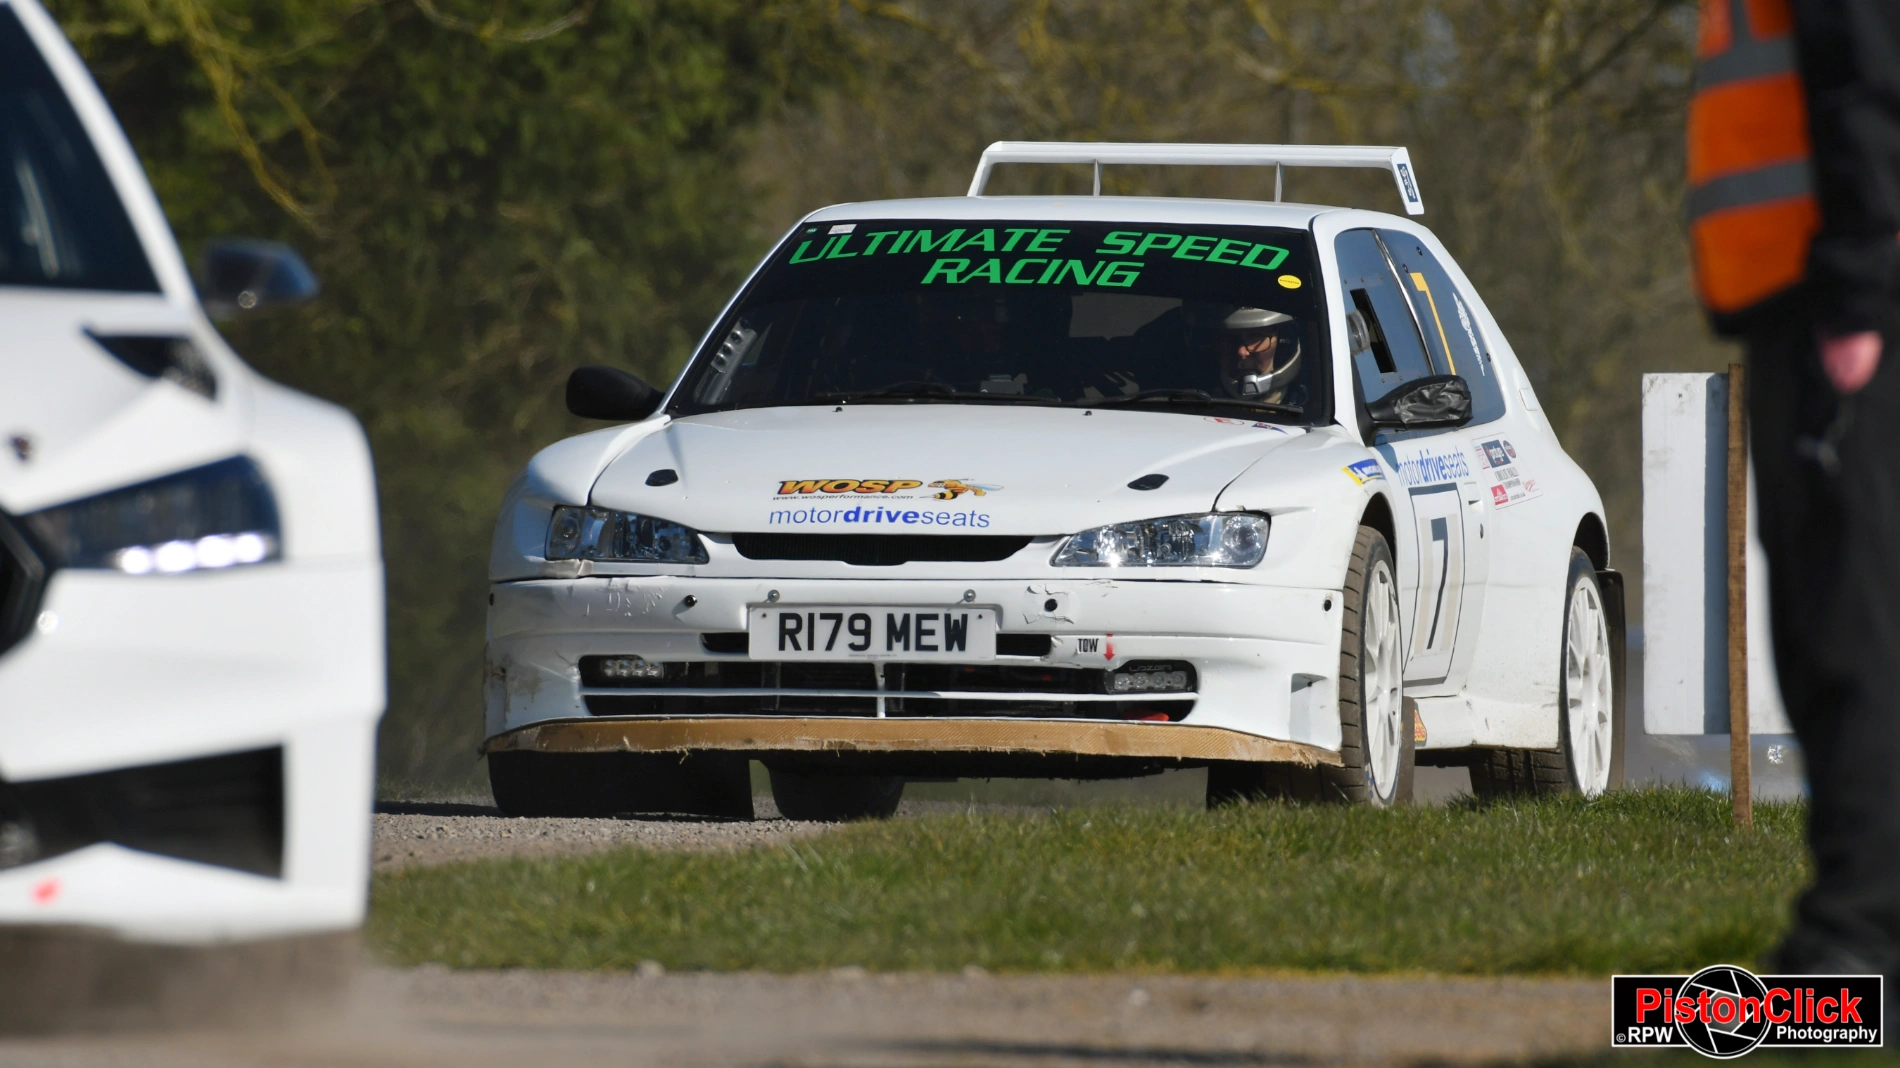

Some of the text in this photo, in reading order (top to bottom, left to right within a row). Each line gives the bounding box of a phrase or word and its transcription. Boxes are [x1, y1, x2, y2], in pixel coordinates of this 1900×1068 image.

[789, 228, 1291, 270] ULTIMATE SPEED
[920, 258, 1146, 288] RACING
[1397, 446, 1469, 487] motordriveseats
[776, 479, 923, 494] WOSP
[769, 506, 990, 528] motordriveseats
[1427, 516, 1449, 650] 7
[778, 612, 969, 651] R179 MEW
[1078, 638, 1099, 652] TOW
